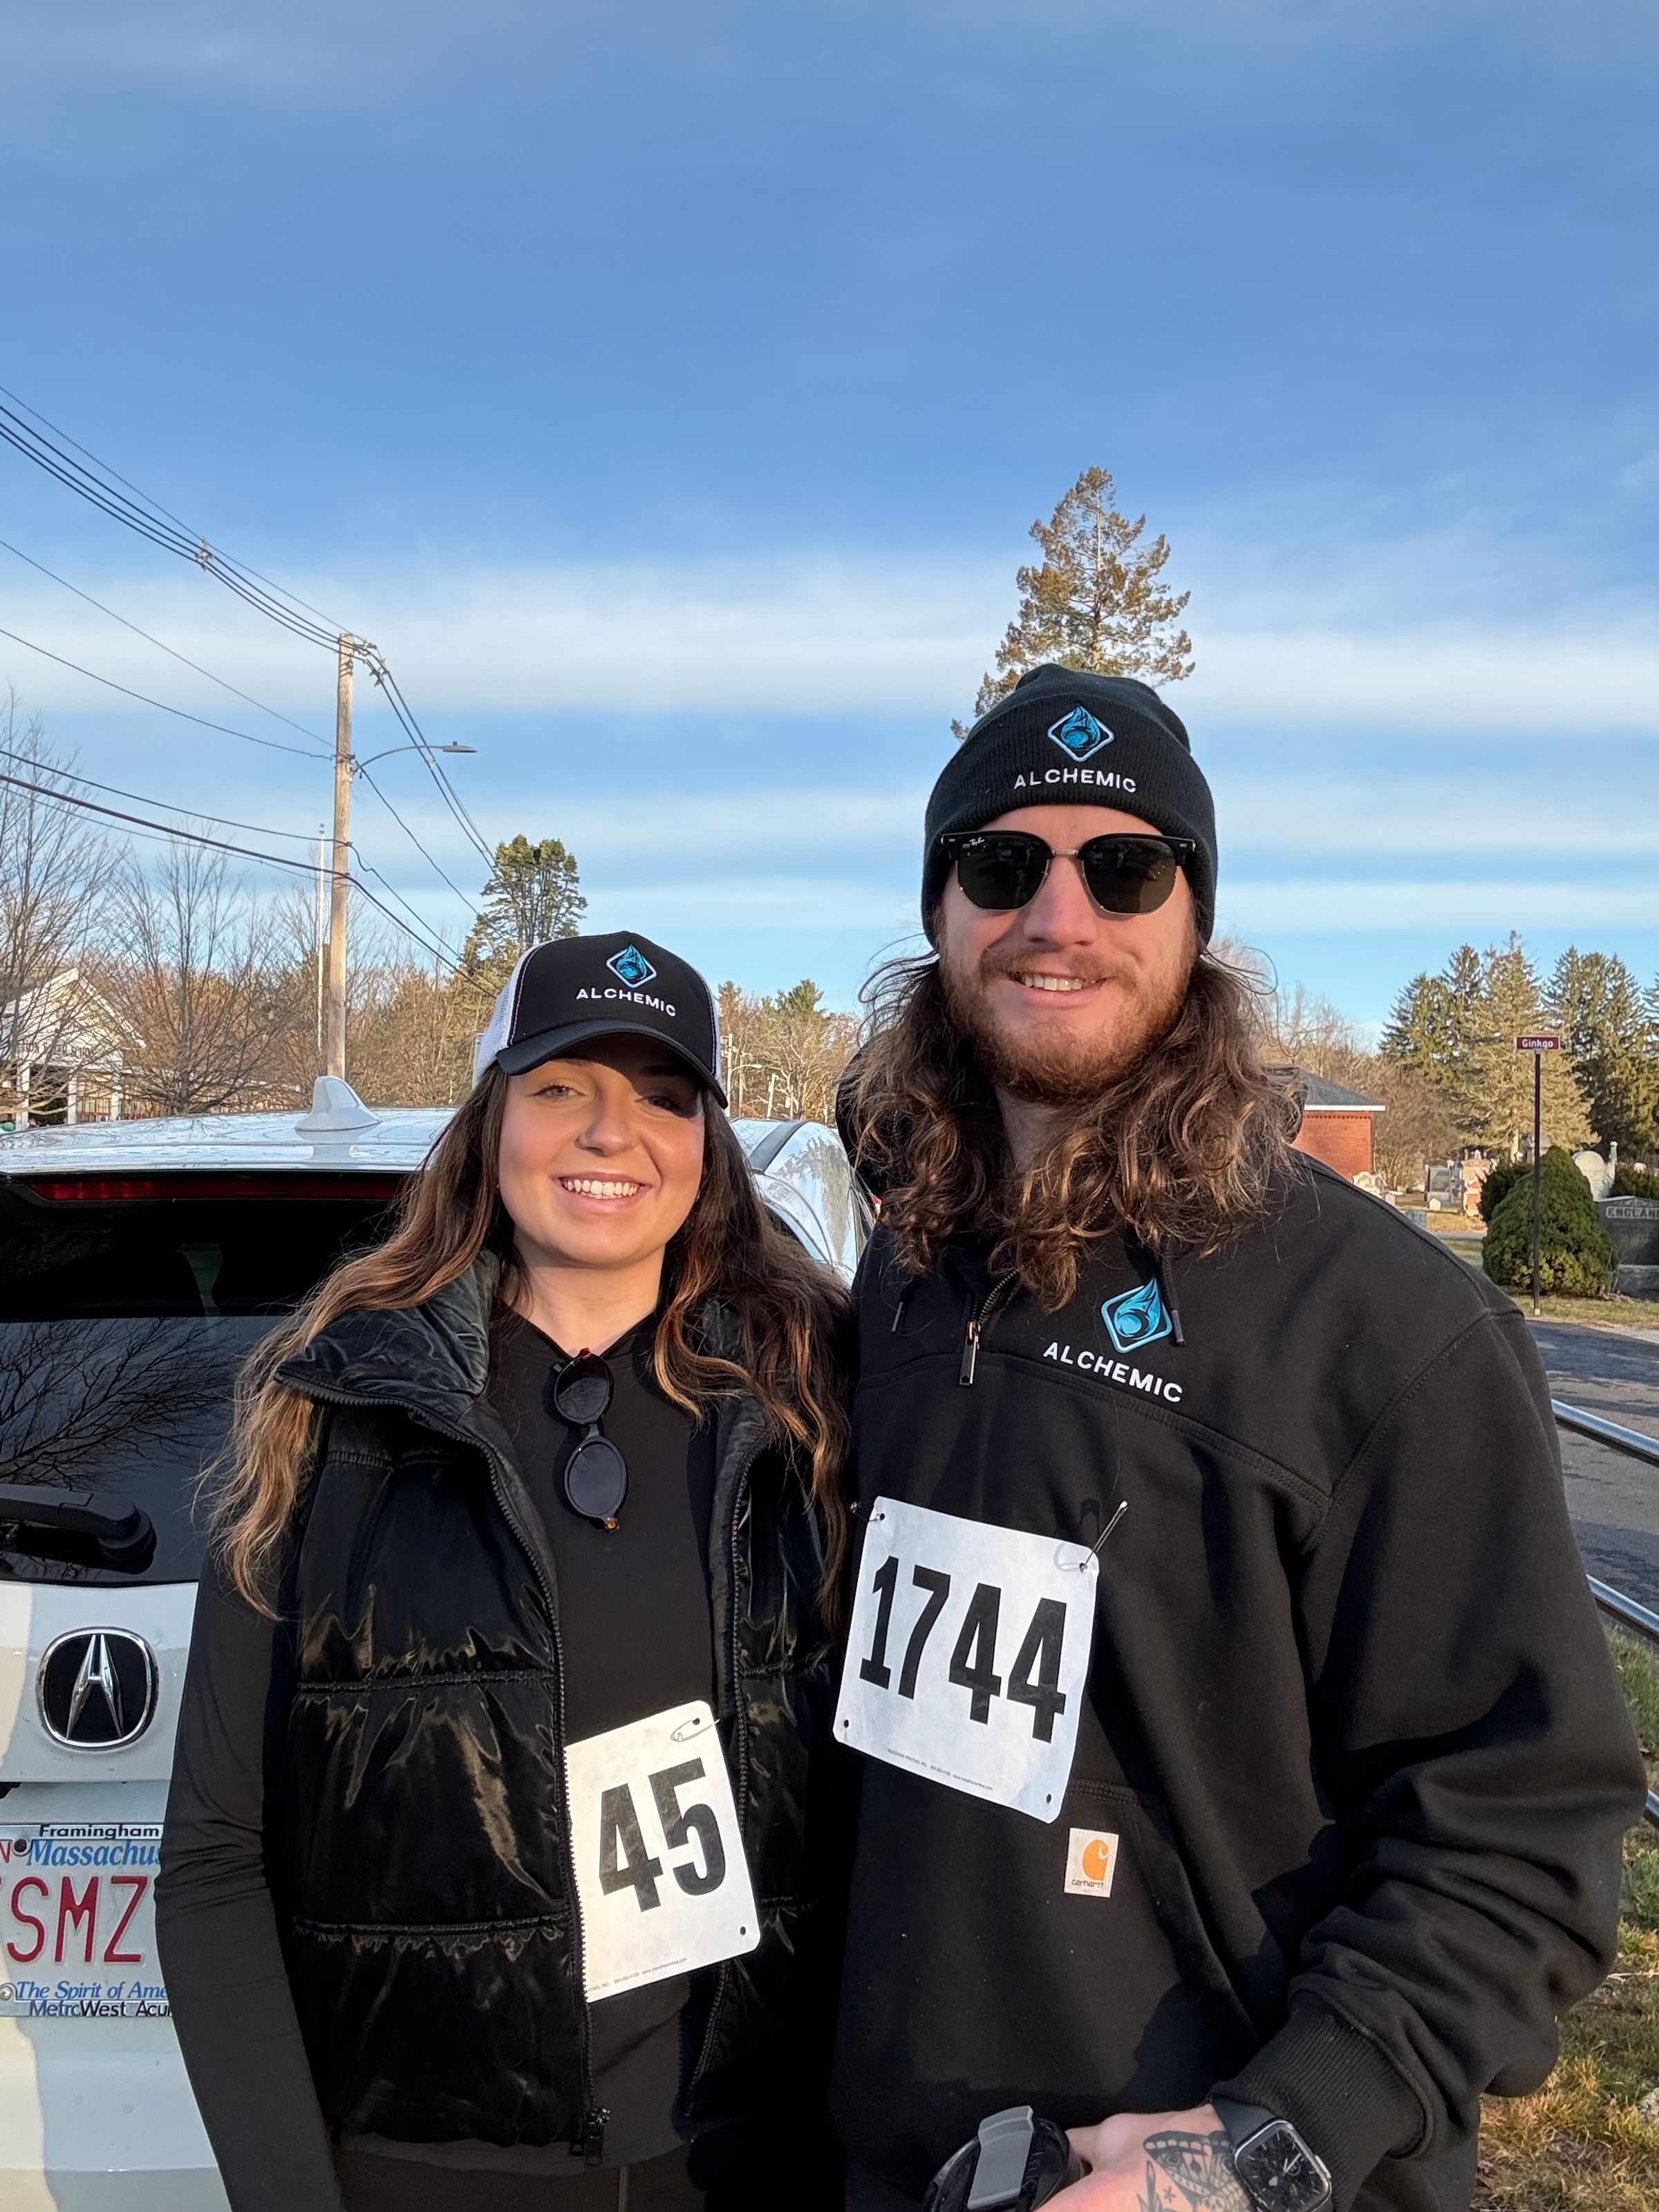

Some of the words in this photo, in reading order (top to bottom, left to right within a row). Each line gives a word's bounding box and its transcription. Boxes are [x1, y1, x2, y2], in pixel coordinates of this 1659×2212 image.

[1013, 767, 1137, 794] ALCHEMIC
[575, 987, 677, 1018] ALCHEMIC
[1521, 1038, 1554, 1050] Ginkgo
[1607, 1207, 1659, 1219] ENGLAN
[1042, 1341, 1183, 1403] ALCHEMIC
[859, 1555, 1068, 1745] 1744
[39, 1824, 160, 1840] Framingham
[599, 1756, 727, 1913] 45
[0, 1875, 150, 1962] SMZ
[17, 1981, 50, 1998] The
[55, 1980, 102, 1999] Spirit
[107, 1981, 126, 2000] of
